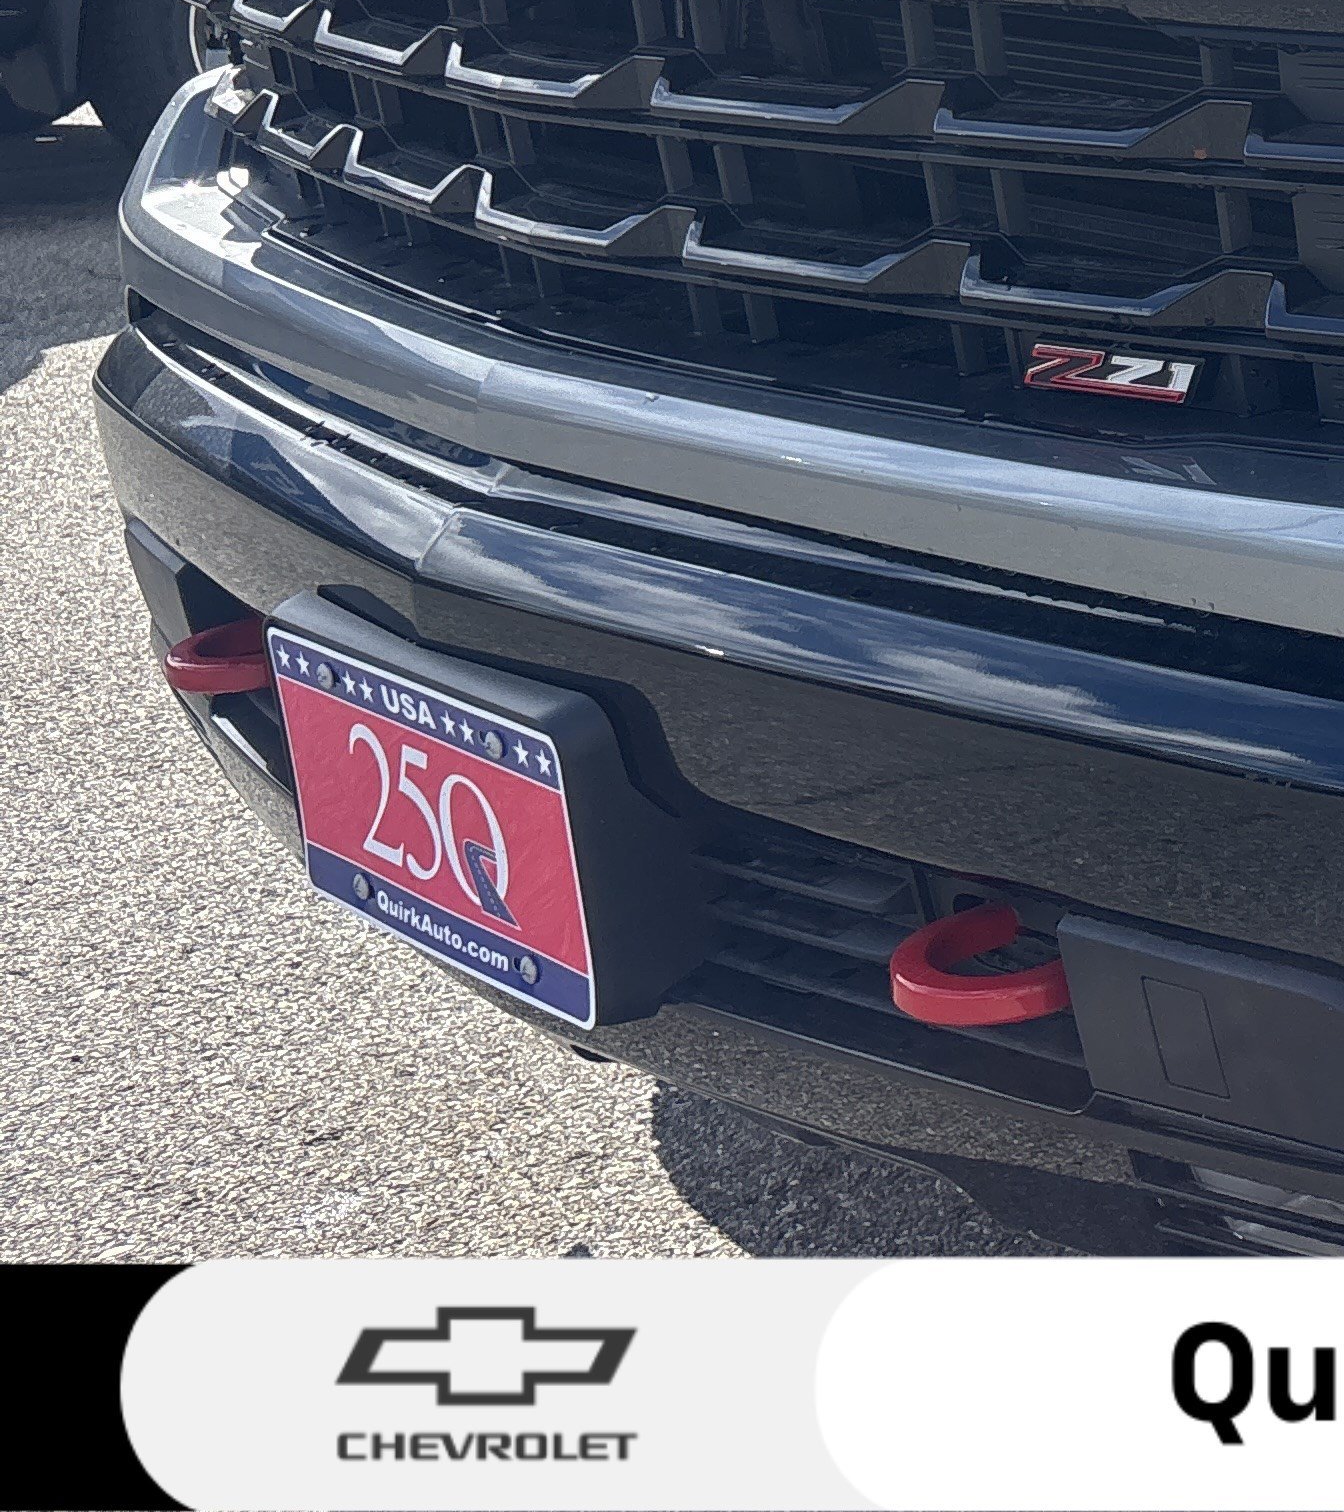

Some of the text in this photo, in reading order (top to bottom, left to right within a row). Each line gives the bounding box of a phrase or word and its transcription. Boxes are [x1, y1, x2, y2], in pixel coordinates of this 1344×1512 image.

[1024, 343, 1196, 405] Z71
[380, 684, 437, 730] USA
[376, 890, 510, 973] QuirkAuto.com
